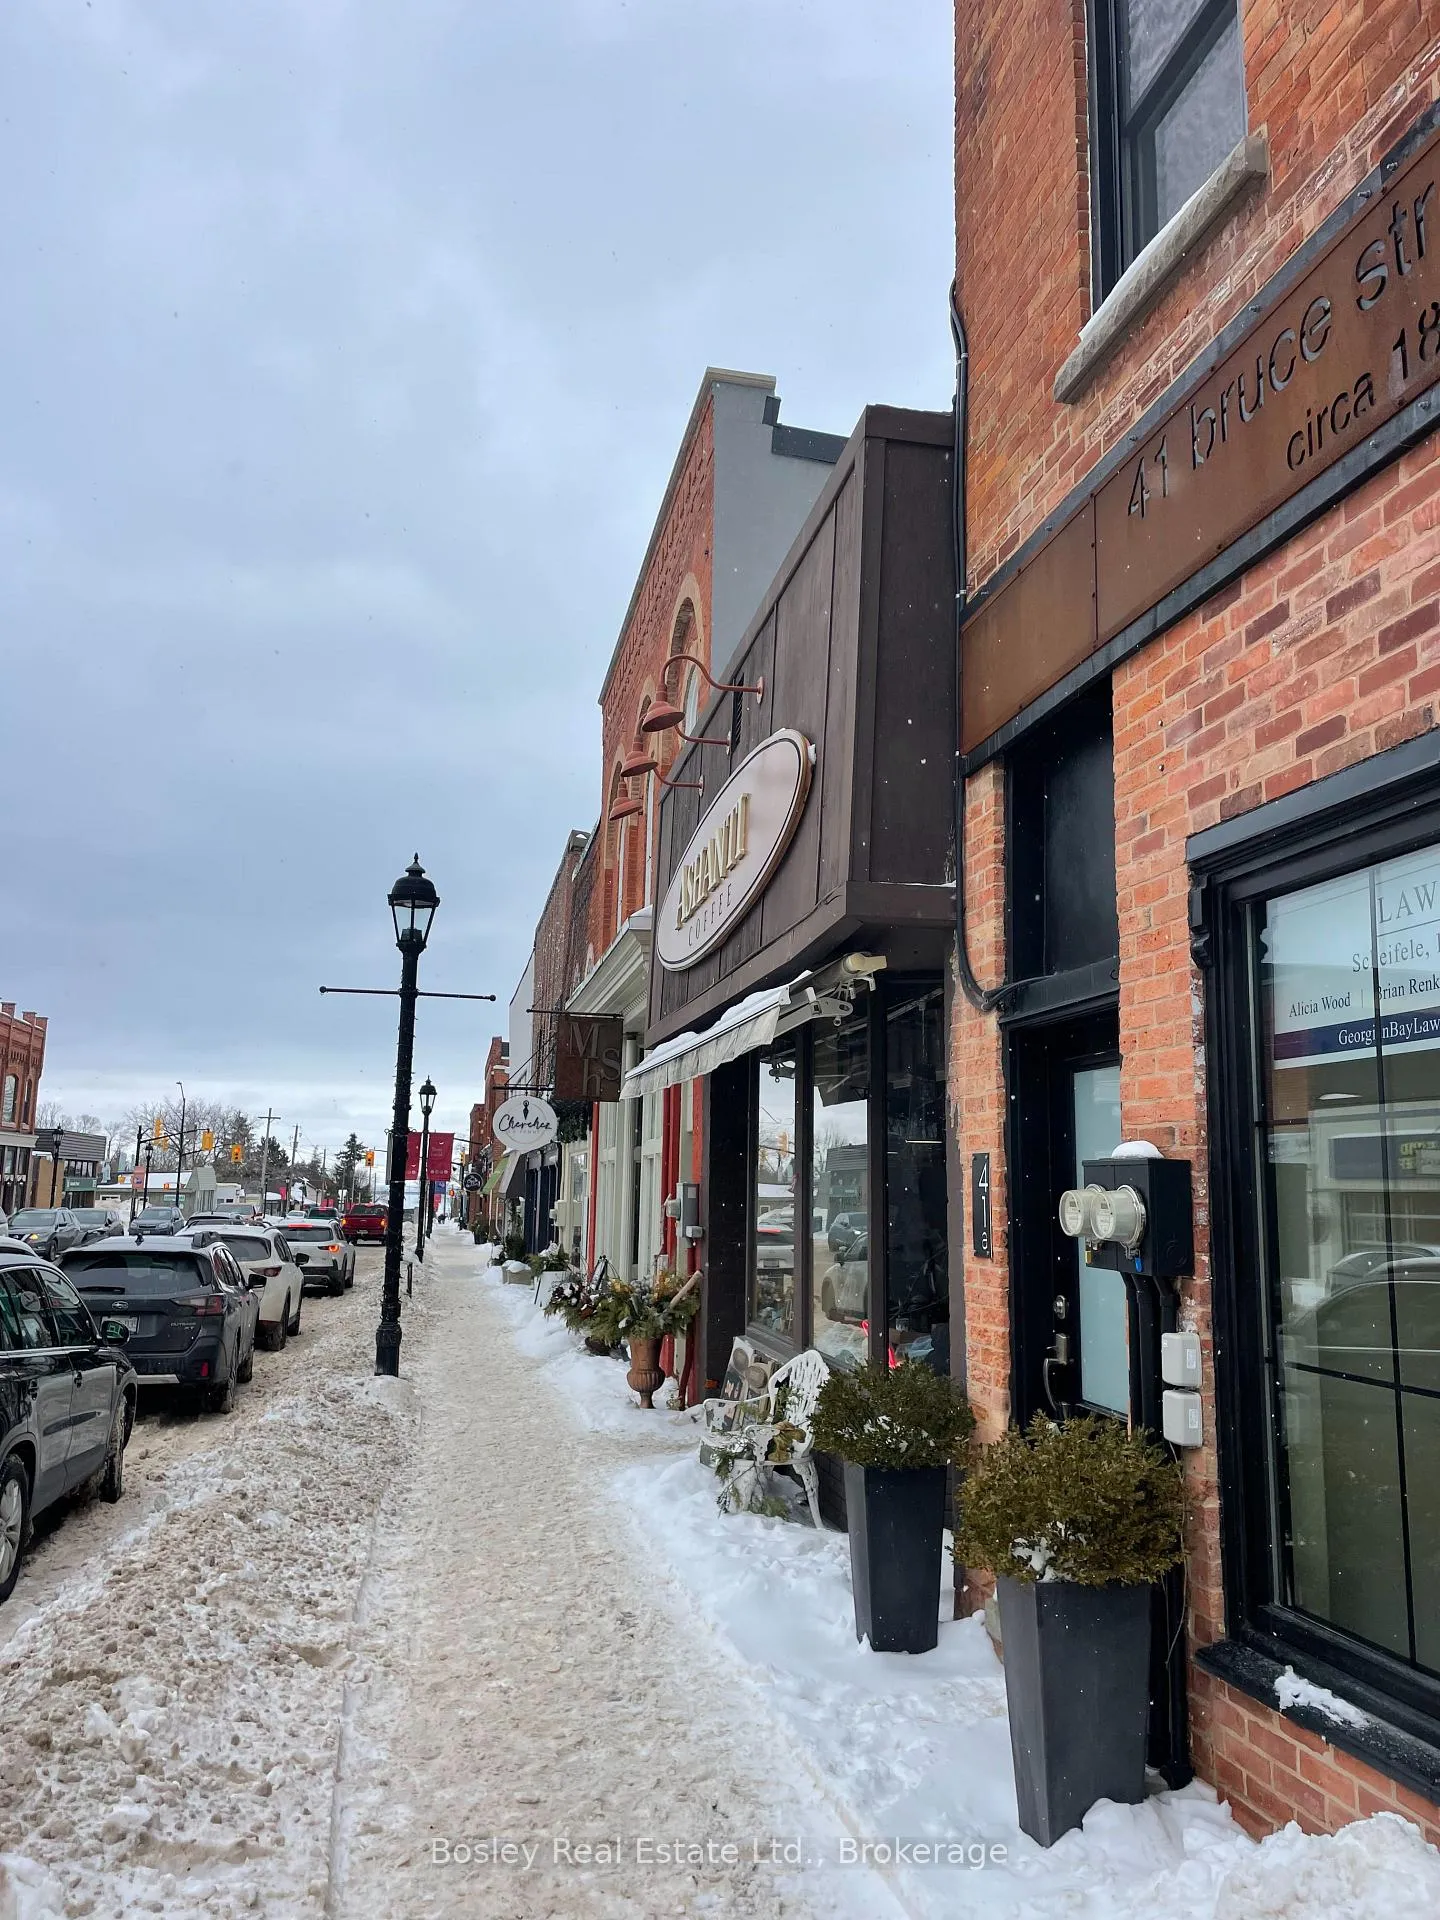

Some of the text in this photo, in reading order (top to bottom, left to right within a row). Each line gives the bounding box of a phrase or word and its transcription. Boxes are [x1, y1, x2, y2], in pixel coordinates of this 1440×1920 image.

[1127, 434, 1169, 518] 41
[1190, 295, 1332, 470] bruce
[1286, 372, 1377, 471] circa
[688, 883, 732, 946] COFFEE
[1377, 881, 1438, 923] LAW
[1352, 939, 1430, 972] Sceifele,
[1289, 1000, 1318, 1017] Alicia
[1321, 991, 1351, 1010] Wood
[1338, 1017, 1440, 1045] GeorginBayLaw
[499, 1114, 552, 1131] Cherchez
